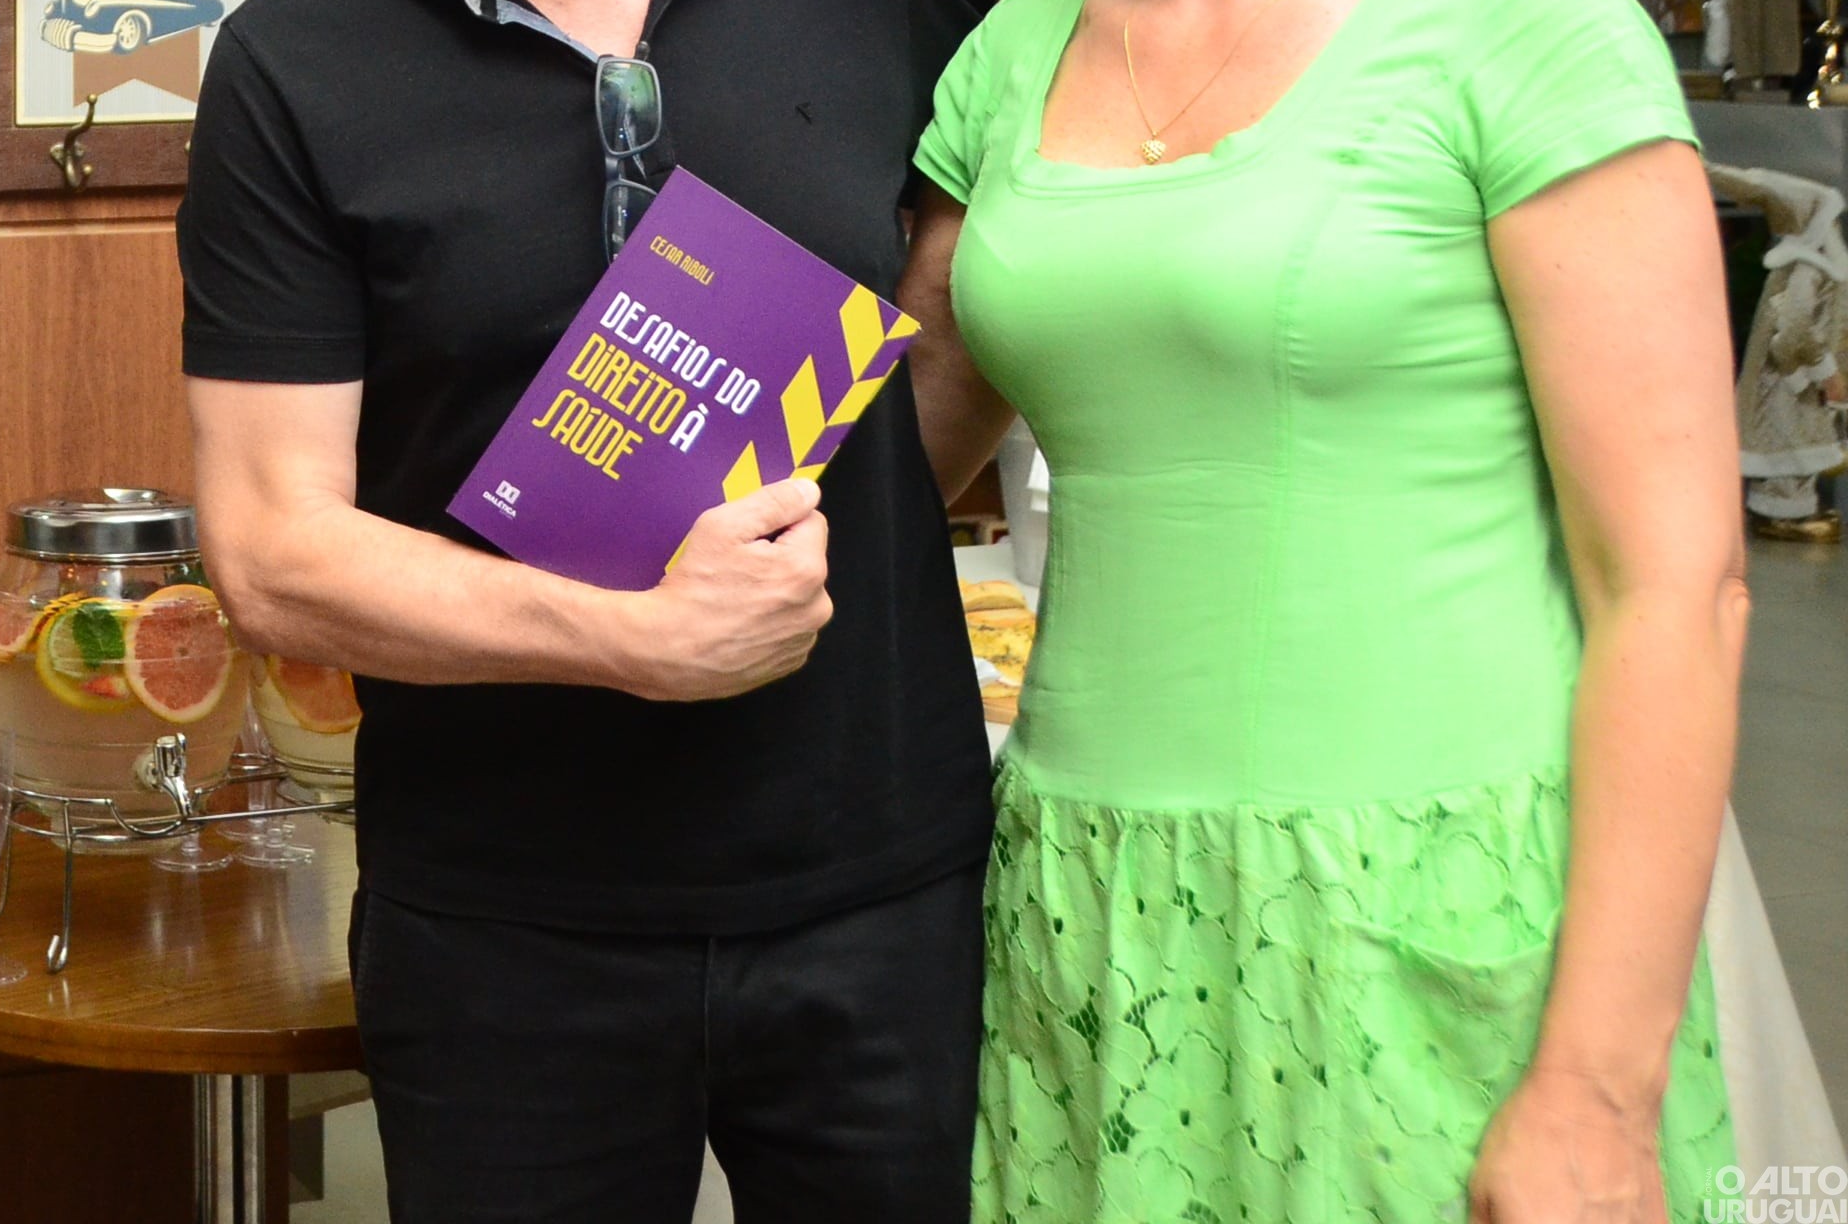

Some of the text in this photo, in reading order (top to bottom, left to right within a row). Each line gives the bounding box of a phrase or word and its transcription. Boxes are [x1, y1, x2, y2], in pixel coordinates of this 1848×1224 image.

[649, 235, 715, 285] CESAR RIBOLI
[567, 332, 709, 453] DIREITO À
[600, 291, 761, 415] DESAFIOS DO
[532, 388, 644, 481] SAÚDE
